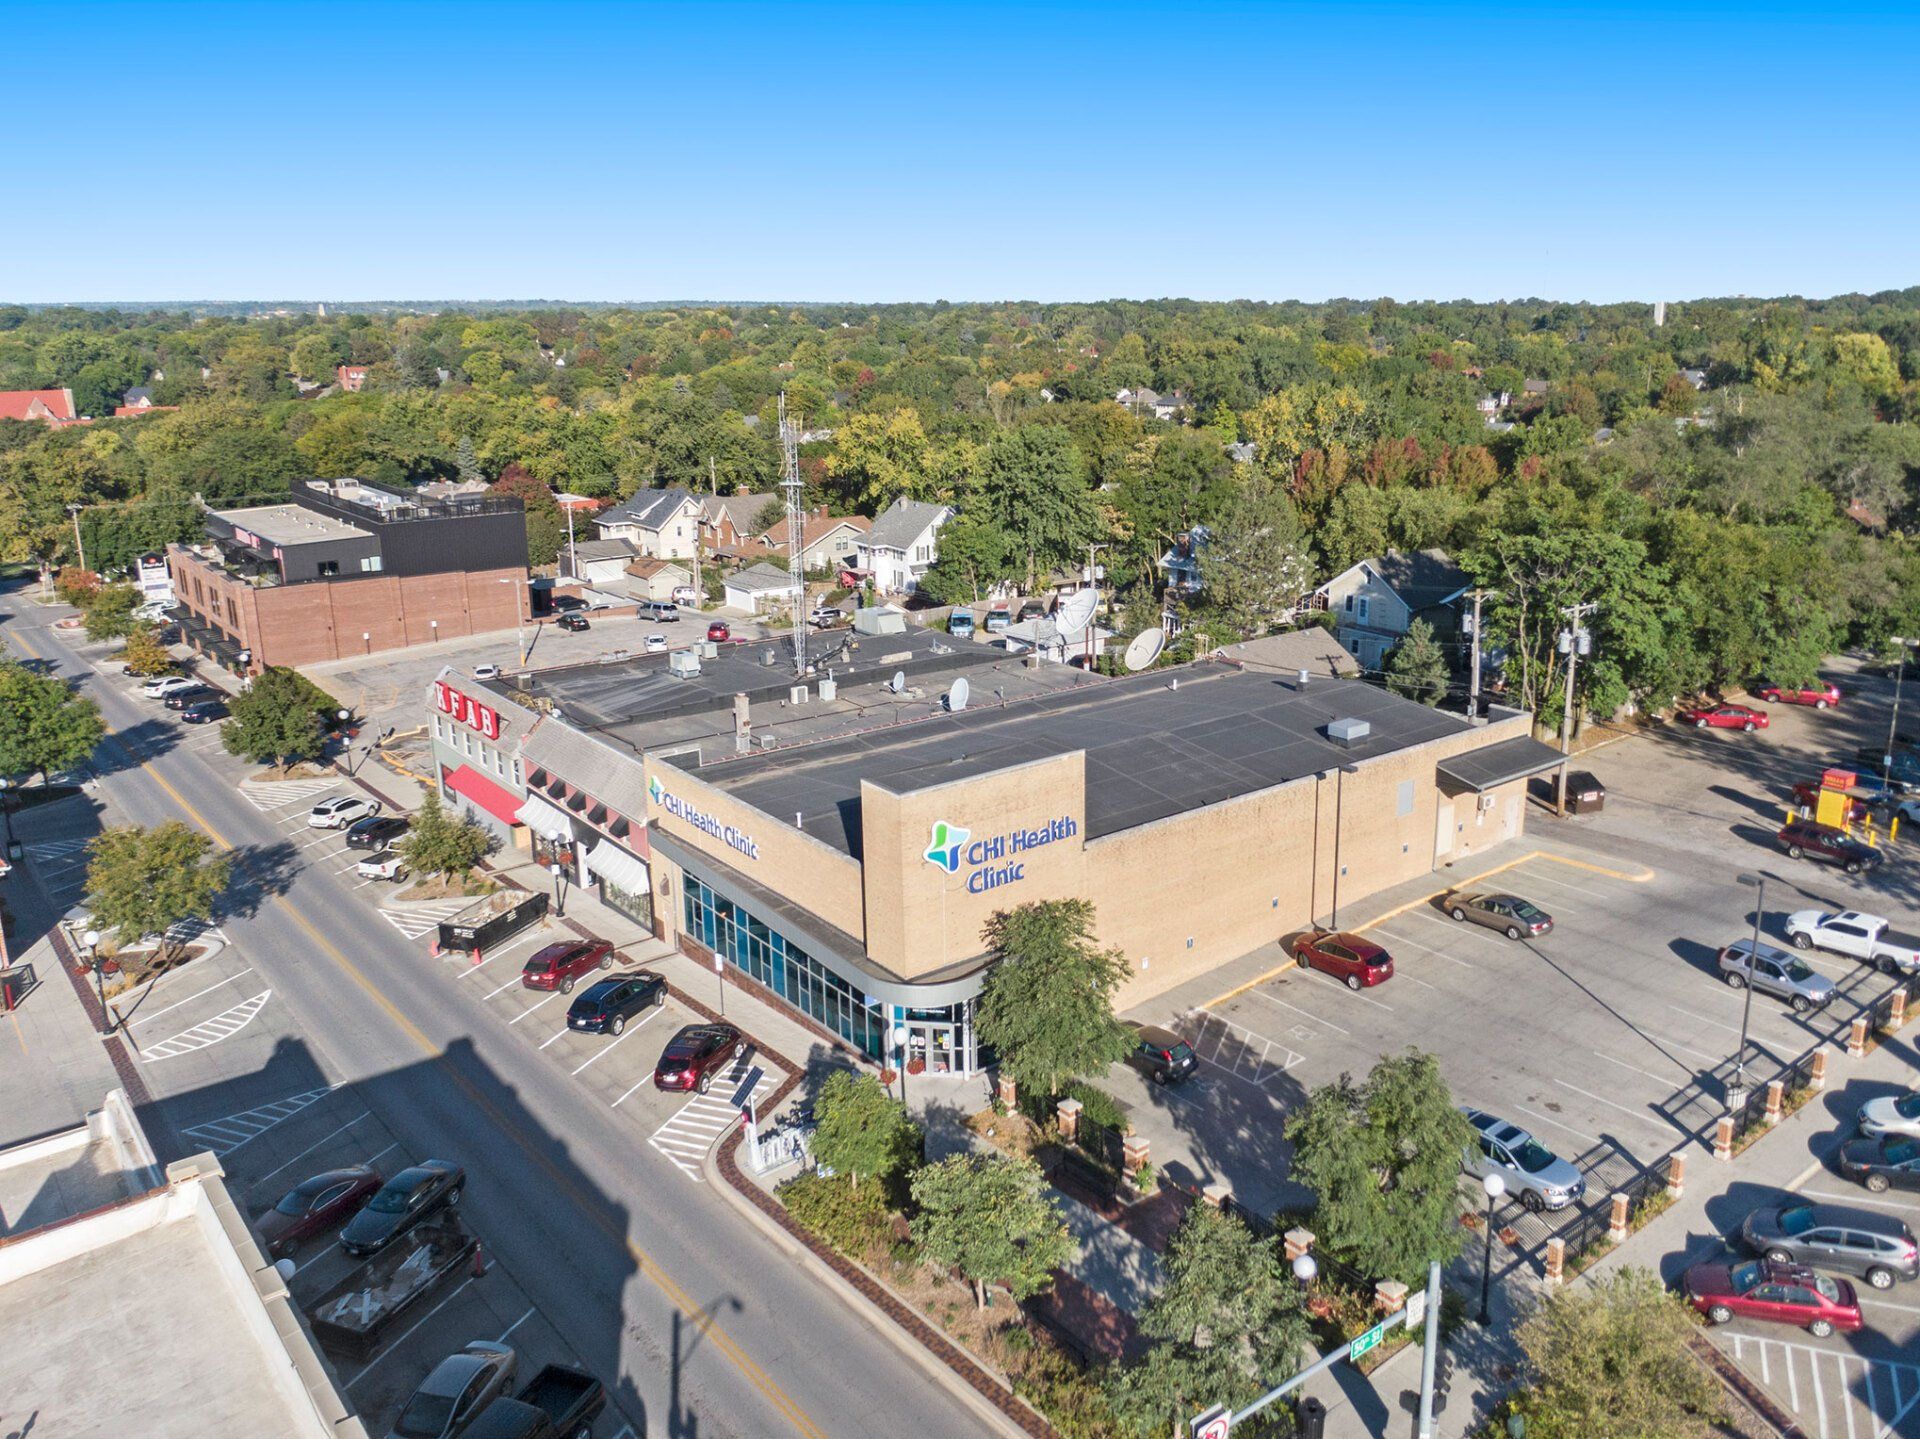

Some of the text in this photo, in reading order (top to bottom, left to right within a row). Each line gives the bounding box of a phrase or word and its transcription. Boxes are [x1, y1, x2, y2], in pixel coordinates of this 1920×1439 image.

[434, 682, 496, 738] KFAB
[663, 791, 761, 862] CHI Health Clinic
[966, 815, 1077, 866] CHI Health
[966, 860, 1025, 895] Clinic
